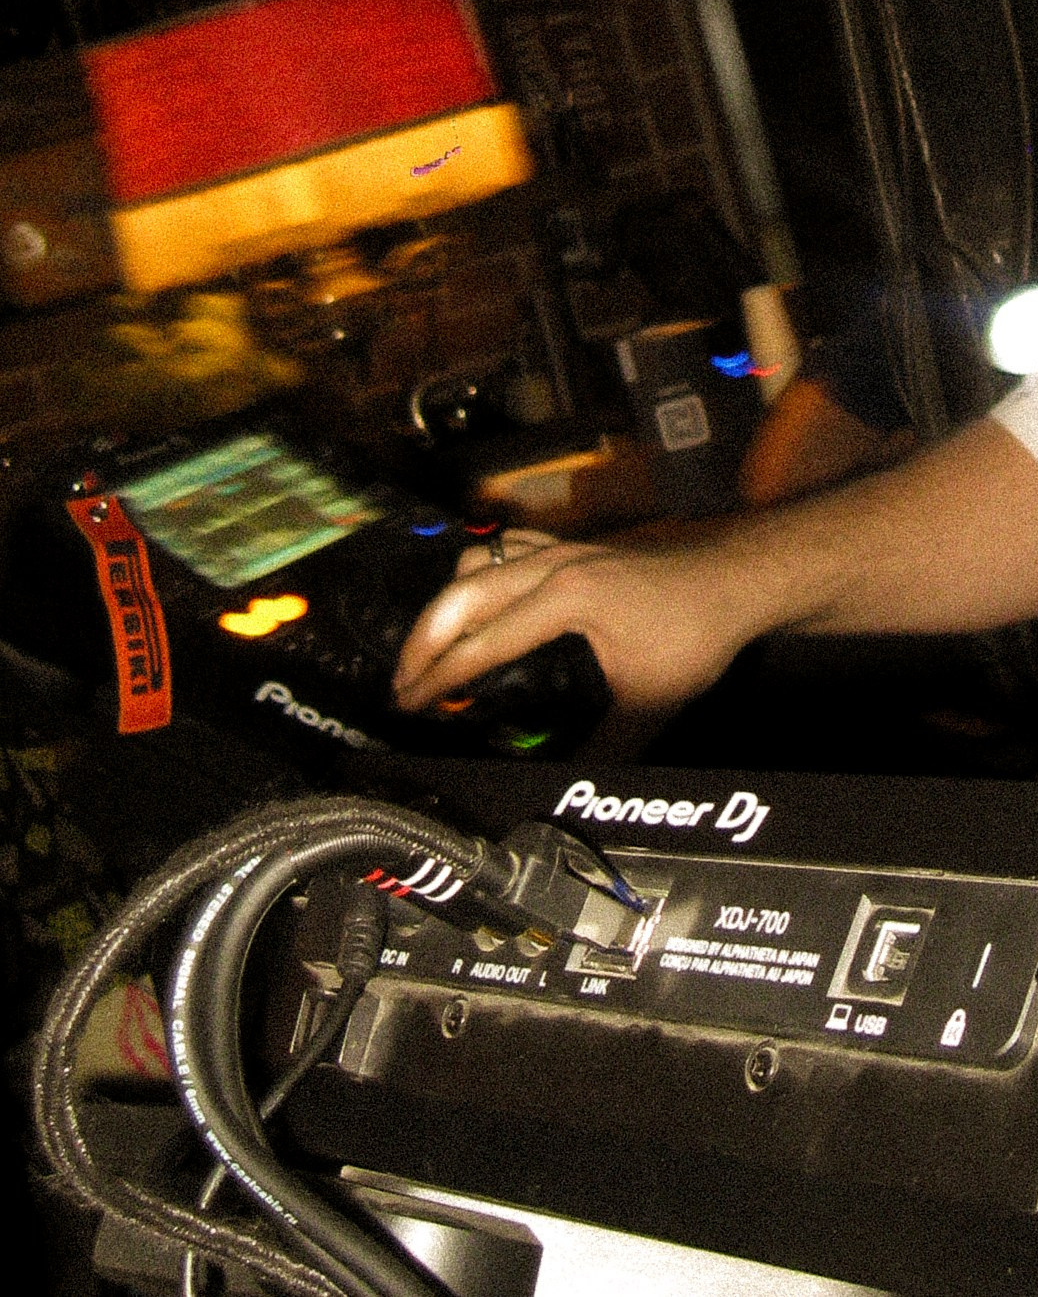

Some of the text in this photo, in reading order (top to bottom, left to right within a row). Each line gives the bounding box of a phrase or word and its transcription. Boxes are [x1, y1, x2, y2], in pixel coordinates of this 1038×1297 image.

[255, 680, 378, 748] Pione
[553, 780, 771, 843] Pioneer DJ
[192, 882, 234, 942] STEREO
[713, 905, 790, 934] XDJ-700
[395, 952, 409, 966] IN
[664, 936, 821, 968] DESIGNED BY ALPHATHETA IN JAPAN
[172, 948, 197, 1010] SIGNAL
[451, 958, 548, 988] R AUDIO OUT L
[580, 977, 611, 995] LINK
[689, 957, 711, 973] PAR
[708, 959, 767, 980] ALPHATHETA
[765, 966, 783, 982] AU
[780, 968, 815, 986] JAPON
[854, 1014, 887, 1036] USB
[172, 1019, 190, 1076] CABLE
